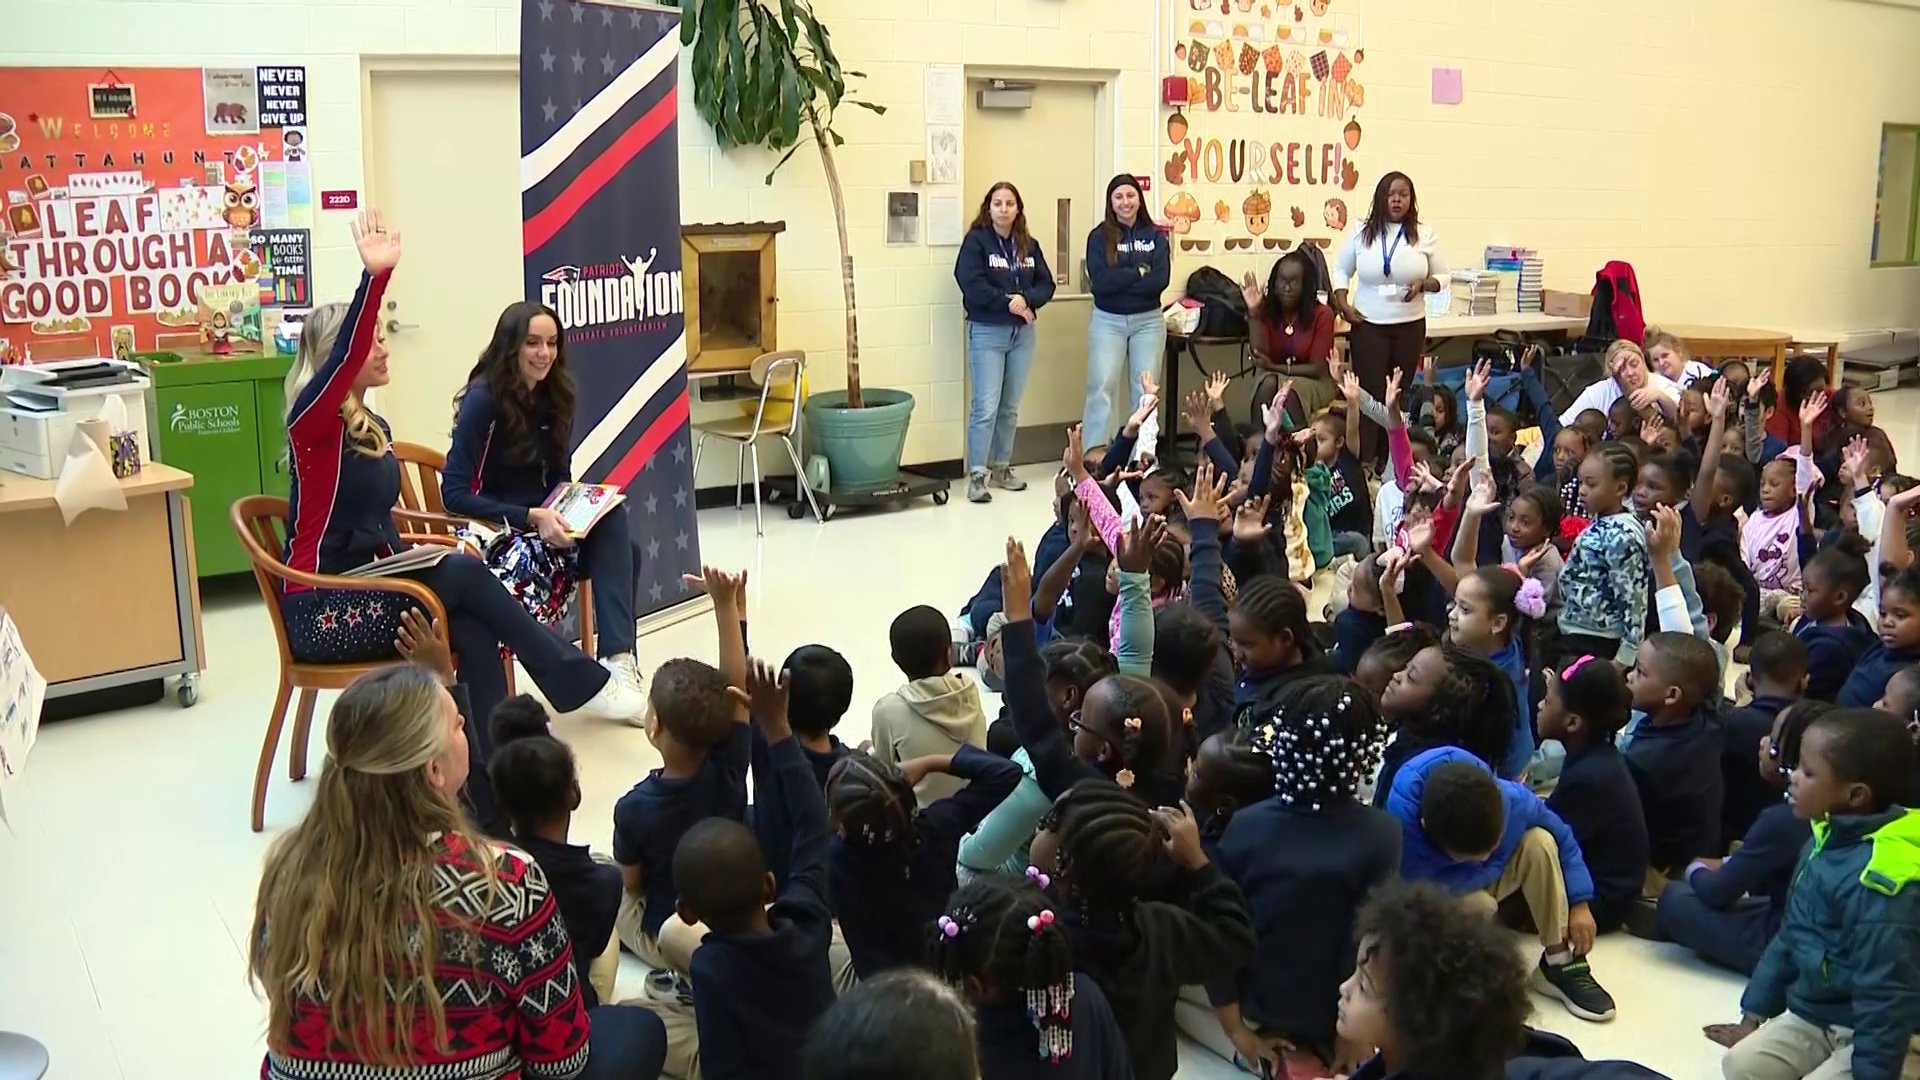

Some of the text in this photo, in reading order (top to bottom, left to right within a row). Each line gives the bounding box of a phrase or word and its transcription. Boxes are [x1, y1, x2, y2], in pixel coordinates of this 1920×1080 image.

[259, 68, 303, 82] NEVER
[263, 85, 300, 96] NEVER
[1205, 66, 1311, 115] BE-LEAF
[266, 100, 298, 109] NEVER
[261, 113, 304, 124] GIVE UP
[39, 117, 172, 140] WELCOME
[0, 152, 234, 169] ATTAHUNT
[1184, 137, 1342, 185] YOURSELF!
[328, 196, 350, 204] 222D
[46, 199, 153, 239] LEAF
[250, 234, 304, 243] SO MANY
[10, 232, 230, 279] THROUGH A
[273, 245, 303, 255] BOOKS
[274, 265, 304, 275] TIME
[583, 263, 624, 278] PATRIOTS
[2, 278, 109, 319] GOOD
[188, 405, 239, 419] BOSTON
[178, 416, 240, 431] Public Schools
